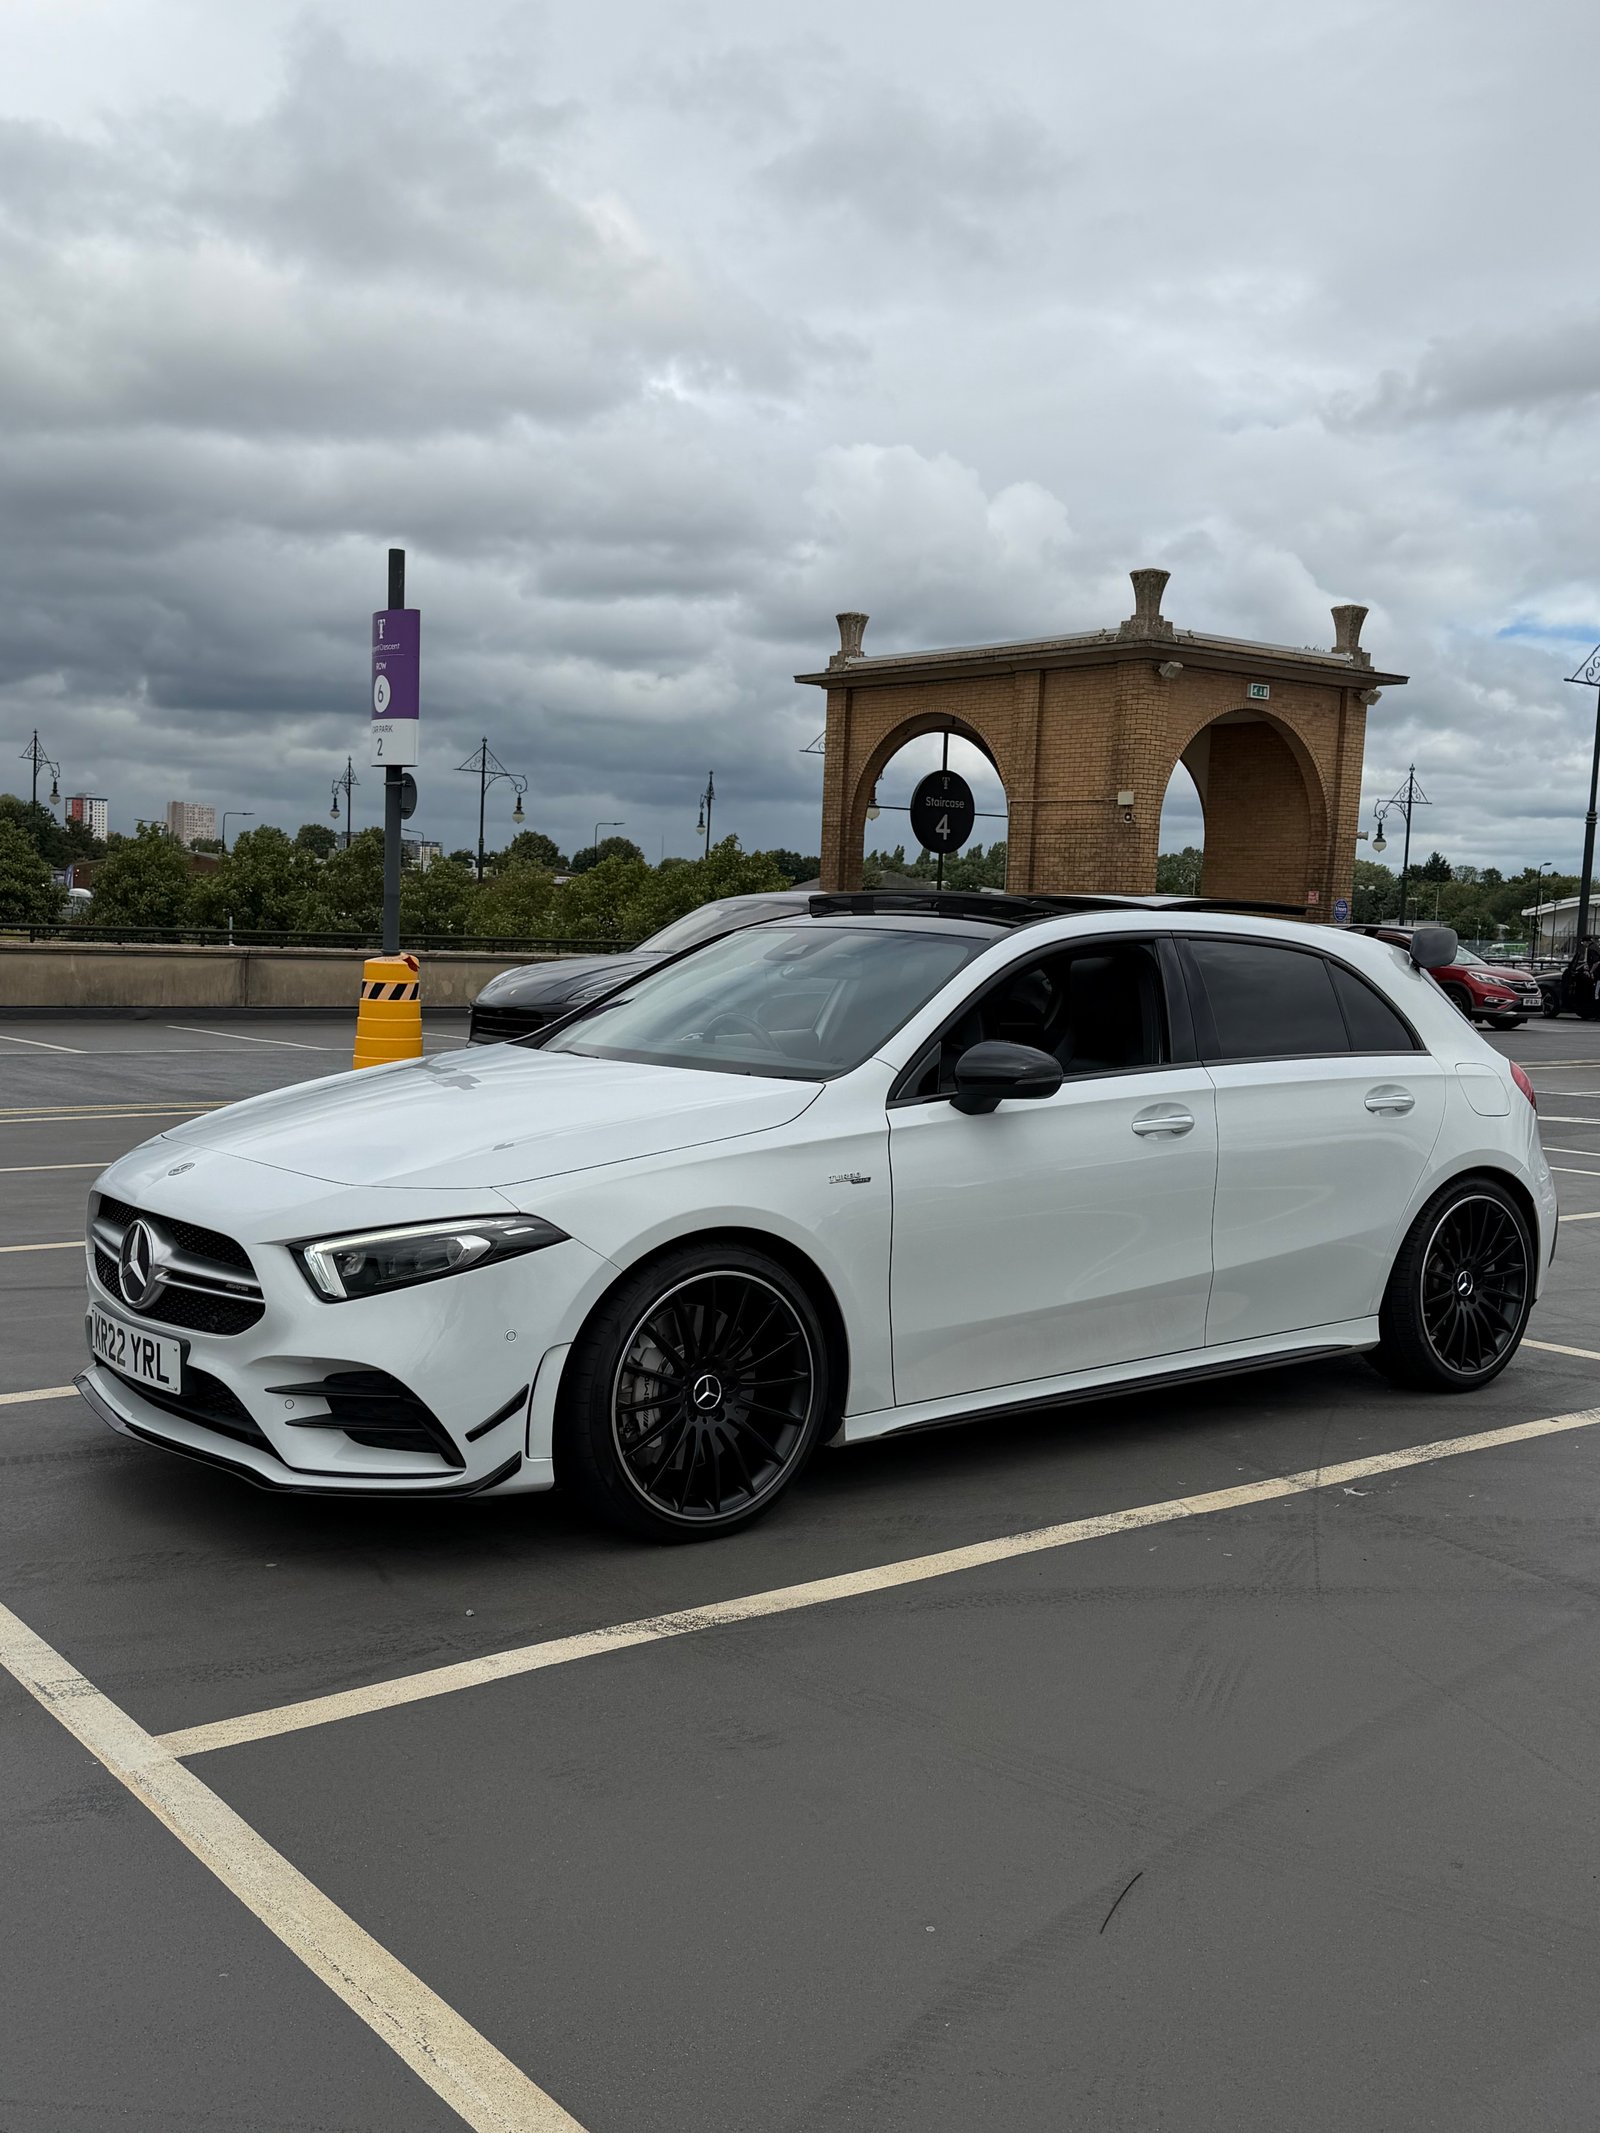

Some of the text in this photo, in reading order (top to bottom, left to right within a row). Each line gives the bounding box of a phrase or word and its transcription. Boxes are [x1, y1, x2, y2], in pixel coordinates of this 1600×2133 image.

[376, 662, 387, 670] ROW
[377, 684, 384, 703] 6
[377, 738, 383, 756] 2
[942, 776, 950, 790] T
[925, 796, 965, 809] Staircase
[935, 813, 951, 841] 4
[94, 1311, 169, 1384] KR22 YRL
